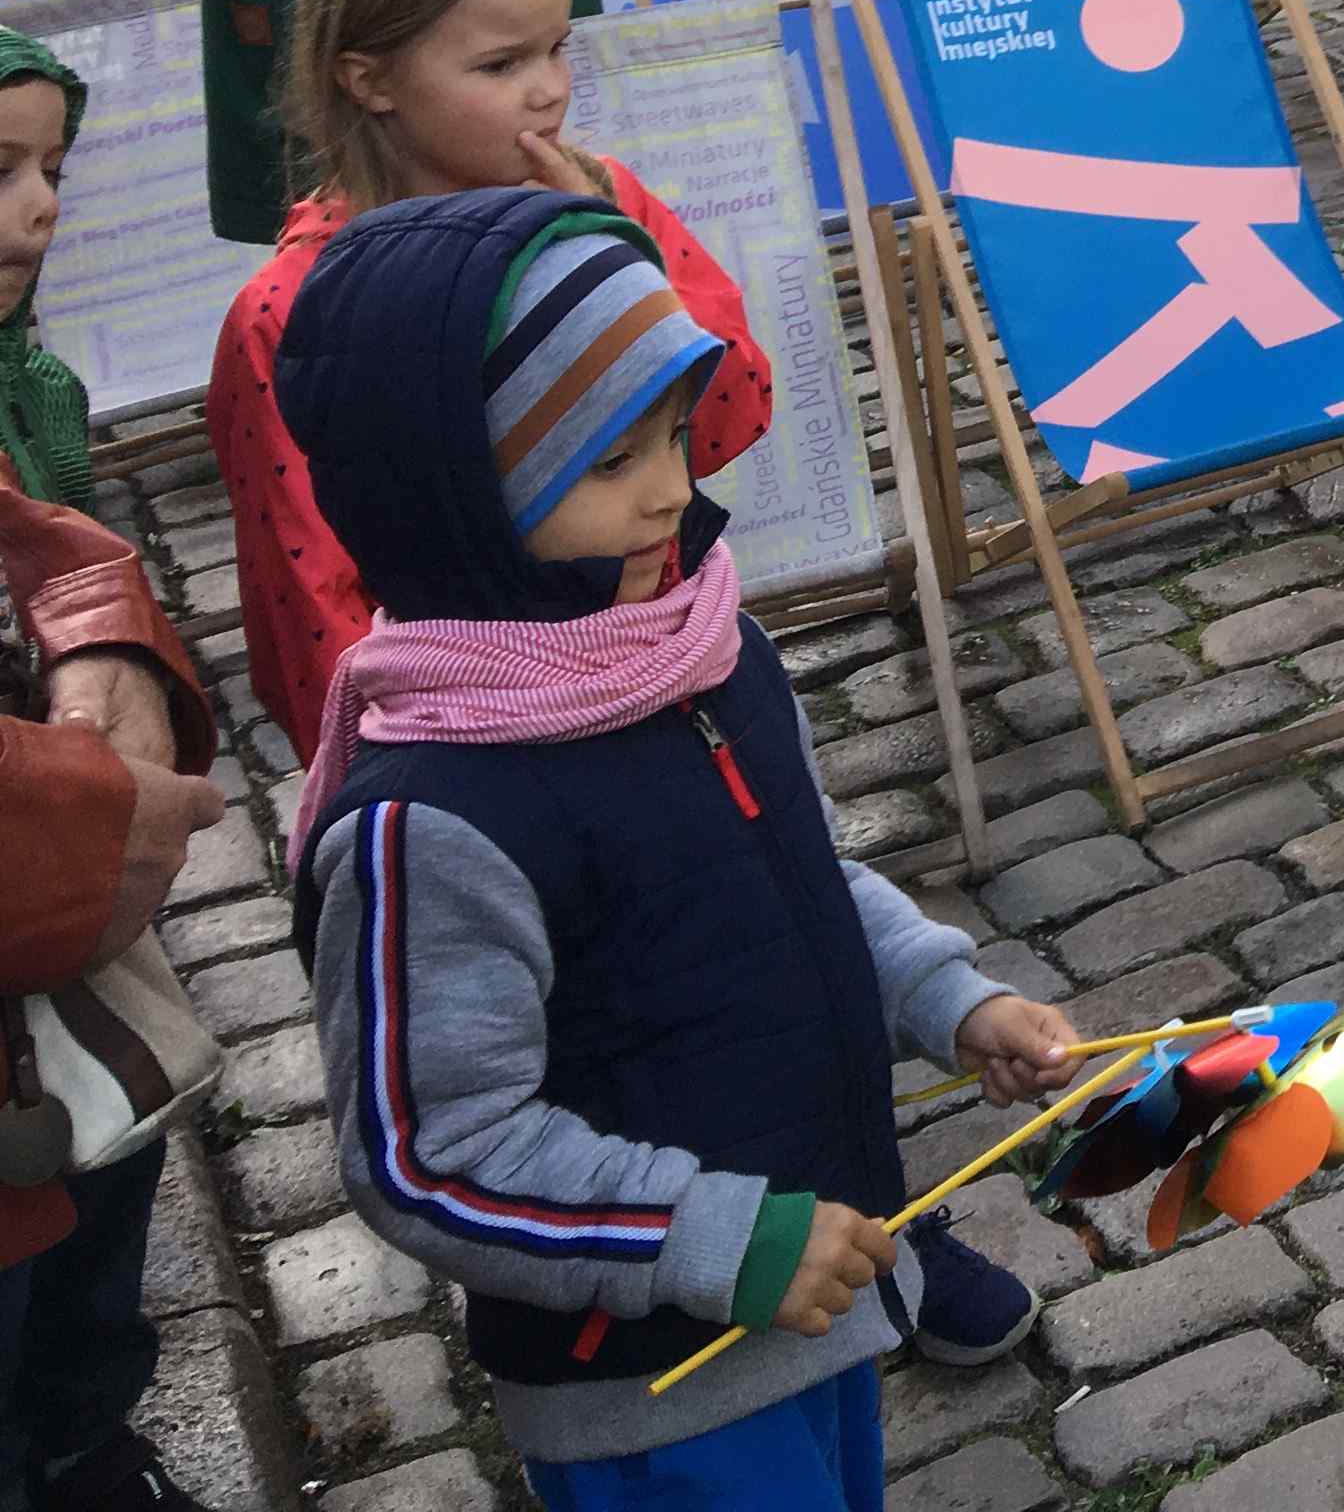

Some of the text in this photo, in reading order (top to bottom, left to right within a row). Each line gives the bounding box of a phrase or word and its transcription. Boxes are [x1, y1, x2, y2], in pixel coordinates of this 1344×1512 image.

[935, 9, 1029, 38] kultury
[939, 28, 1057, 62] miejskiej
[686, 163, 769, 193] Narracje
[773, 253, 852, 544] Gdańskie Miniatury
